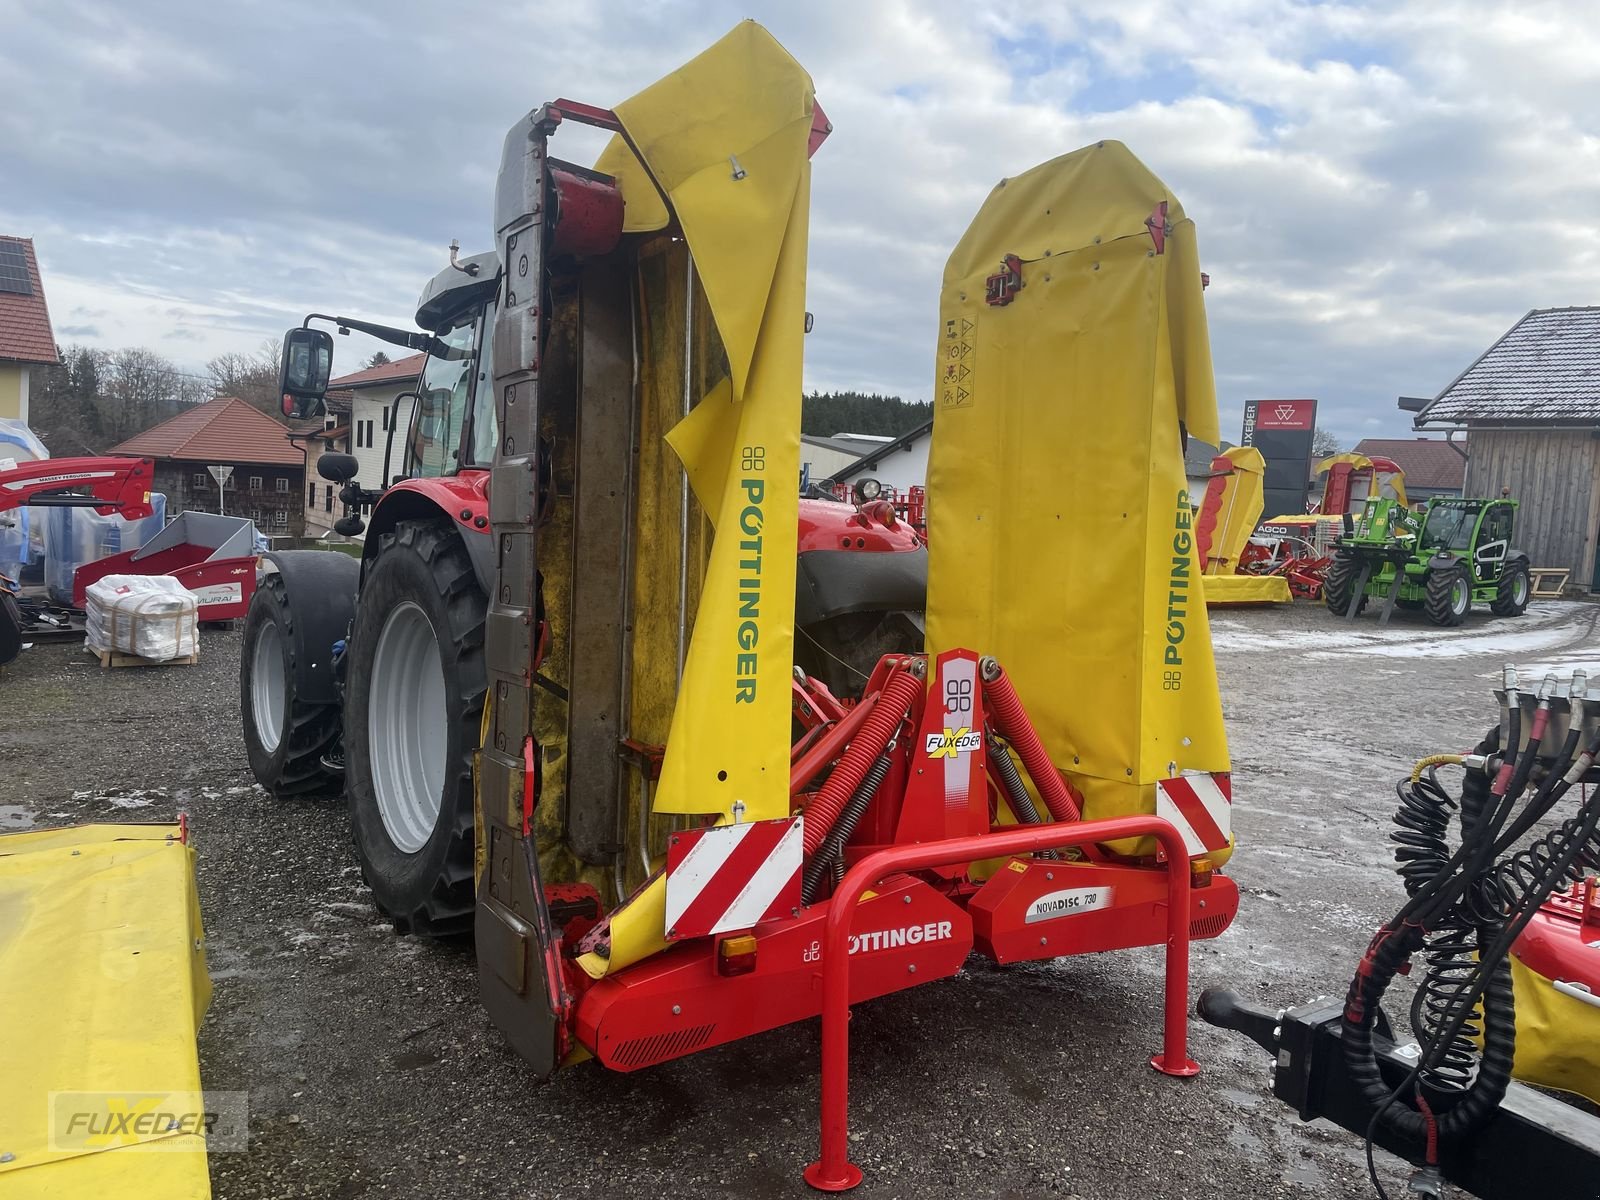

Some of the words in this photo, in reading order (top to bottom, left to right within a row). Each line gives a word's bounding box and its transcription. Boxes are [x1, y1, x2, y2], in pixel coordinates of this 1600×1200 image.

[1243, 405, 1256, 448] LIXEDER
[1257, 525, 1287, 534] AGCO
[1164, 488, 1192, 665] PÖTTINGER
[197, 595, 233, 604] MURAI
[735, 479, 765, 704] PÖTTINGER
[927, 735, 981, 749] FLIXEDER
[1036, 896, 1080, 914] NOVADISC
[1084, 893, 1097, 905] 730
[847, 920, 952, 955] ÖTTINGER
